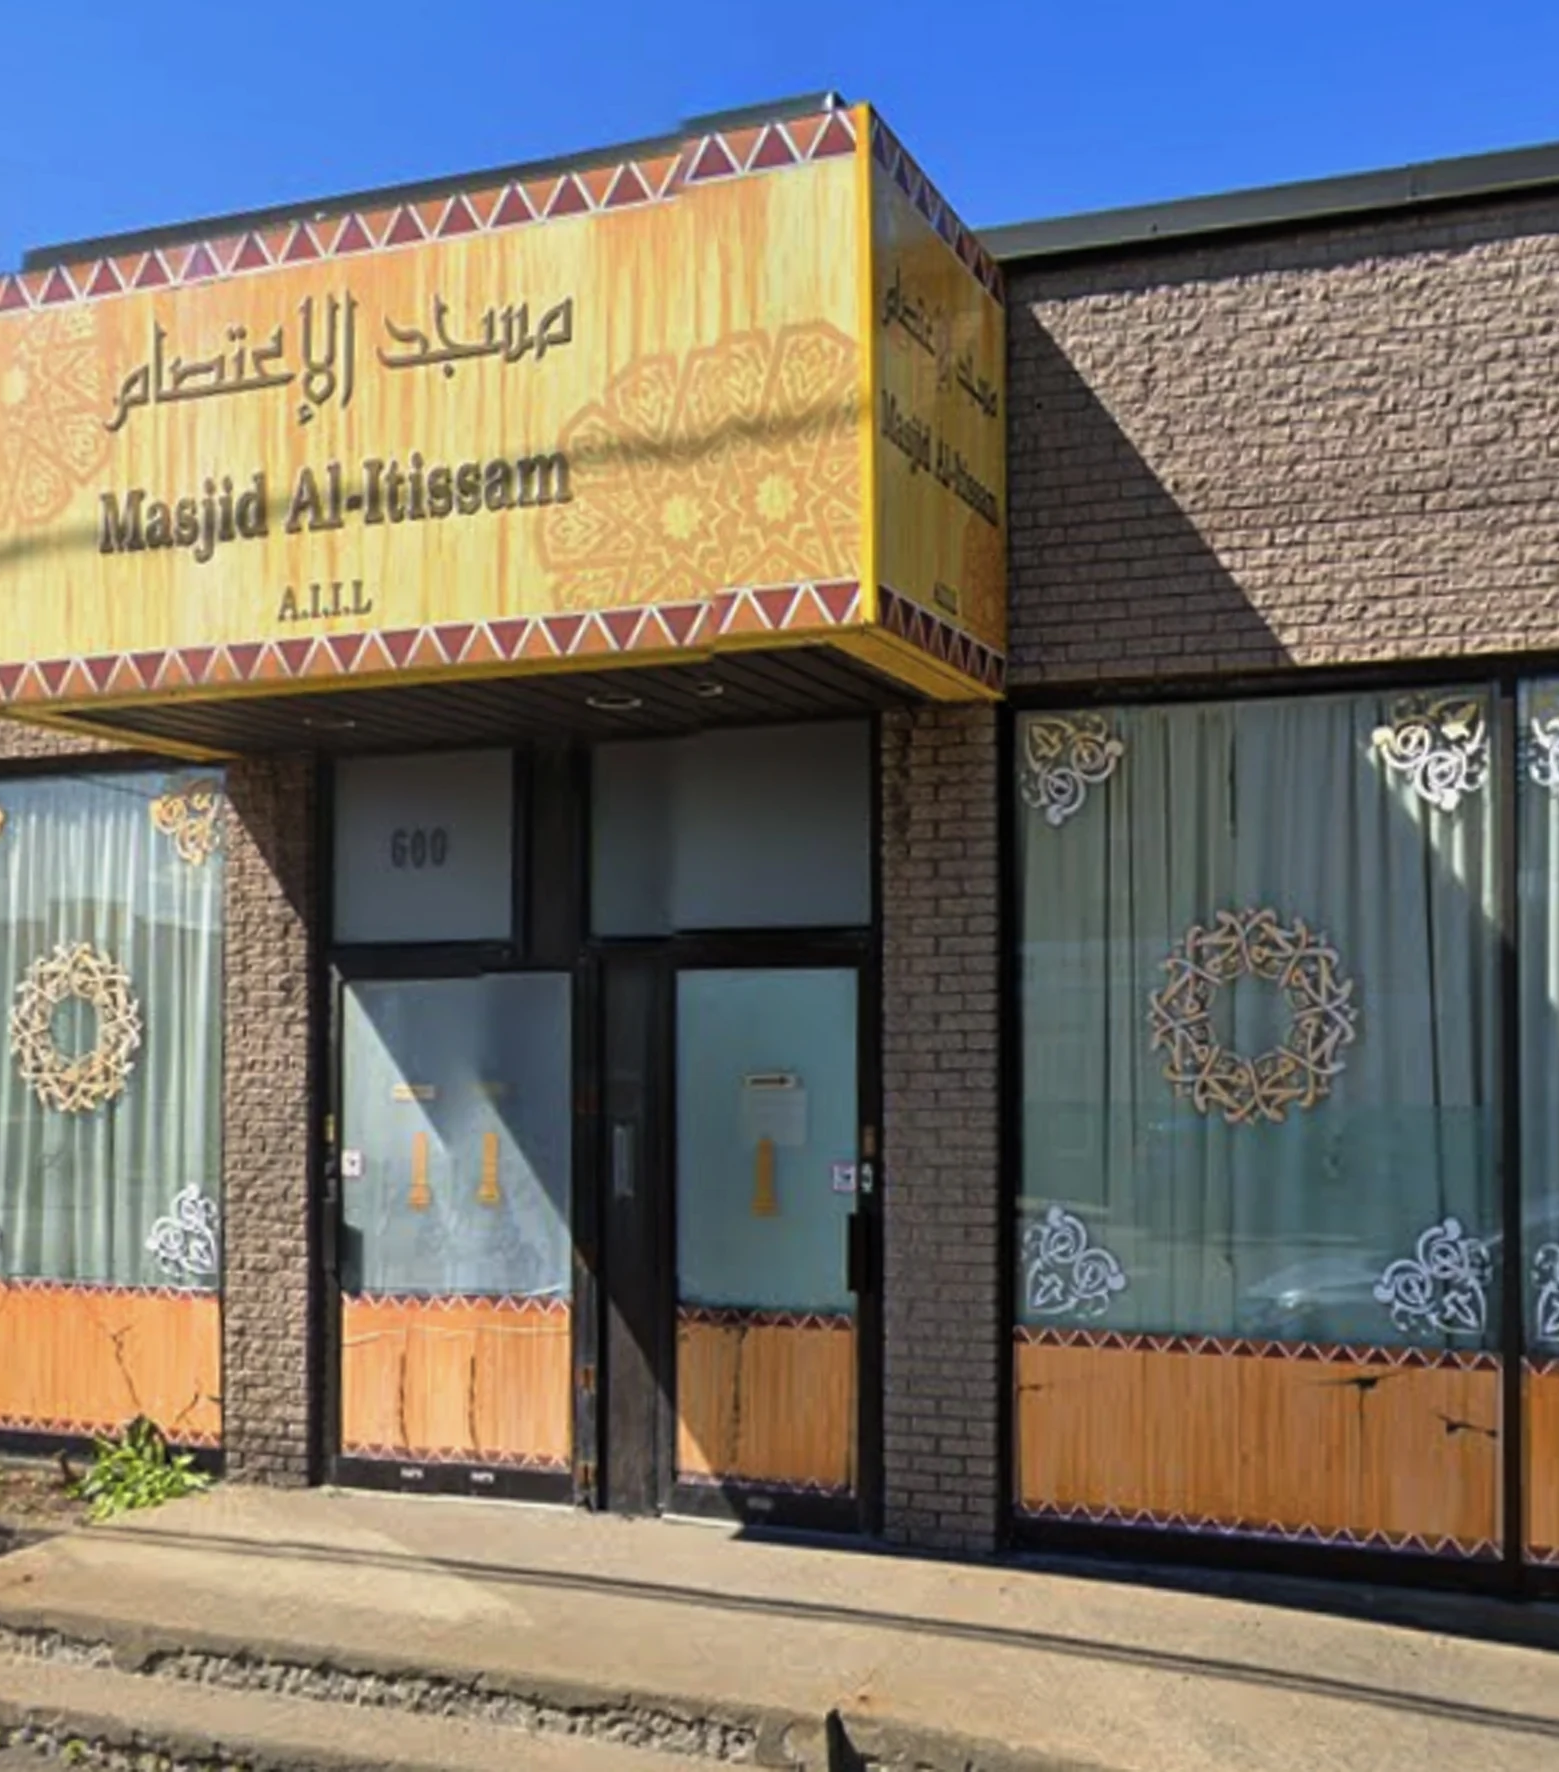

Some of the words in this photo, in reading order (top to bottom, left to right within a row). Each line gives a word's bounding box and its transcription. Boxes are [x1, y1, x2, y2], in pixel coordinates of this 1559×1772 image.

[104, 287, 359, 433] الإعتصام
[376, 294, 573, 379] مسجد
[98, 471, 269, 563] Masjid
[284, 450, 574, 534] Al-Itissam
[391, 826, 448, 869] 600
